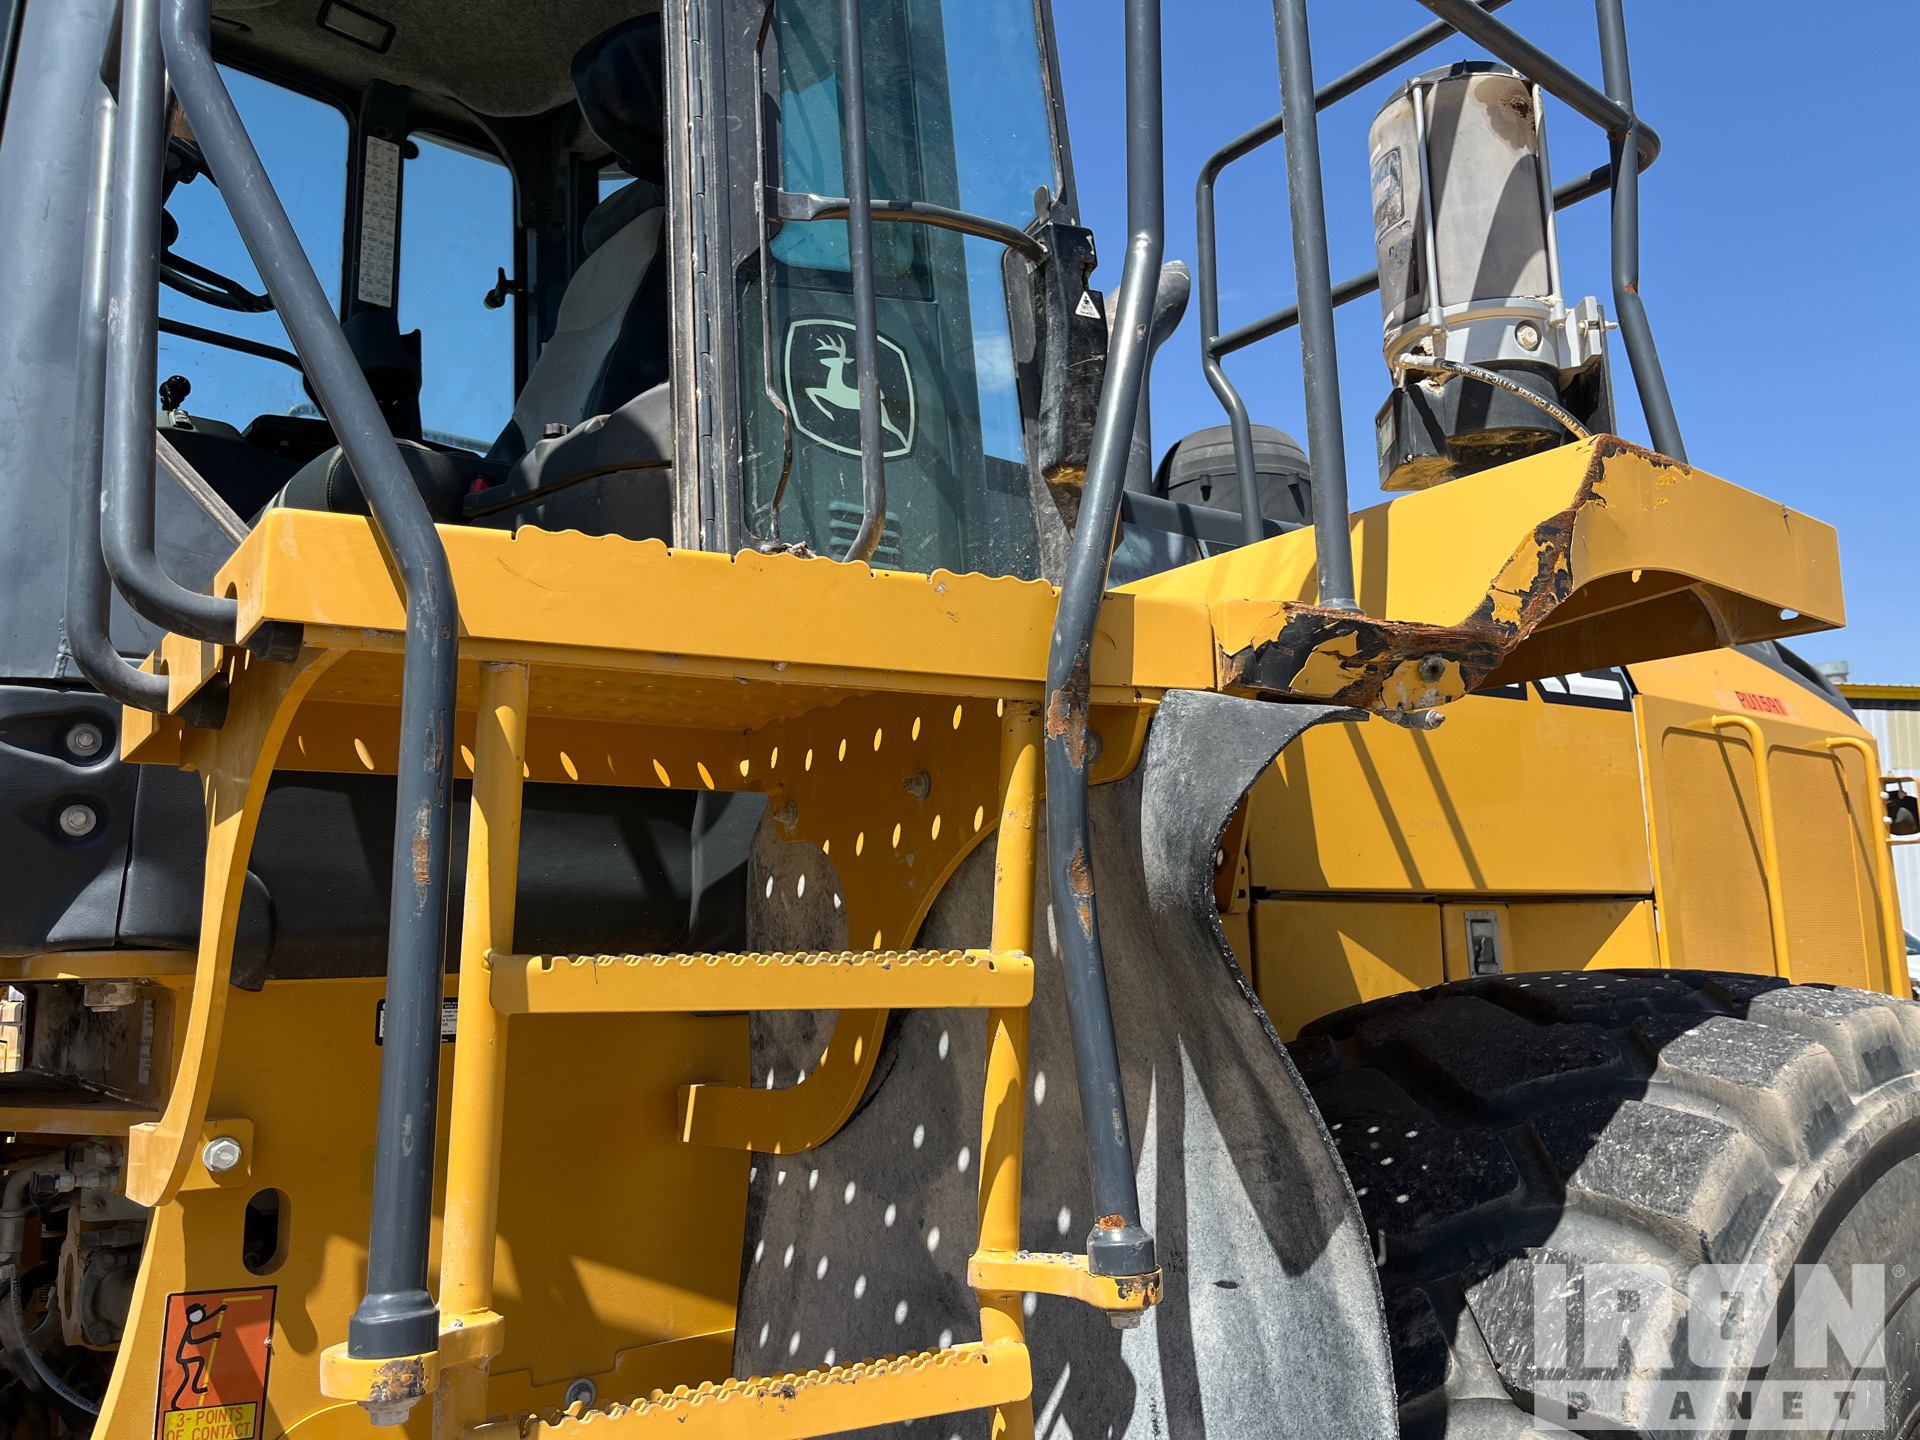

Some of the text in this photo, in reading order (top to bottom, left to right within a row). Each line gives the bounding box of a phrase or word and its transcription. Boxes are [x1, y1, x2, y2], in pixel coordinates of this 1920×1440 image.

[196, 1406, 244, 1426] POINTS
[166, 1422, 252, 1440] OF CONTACT
